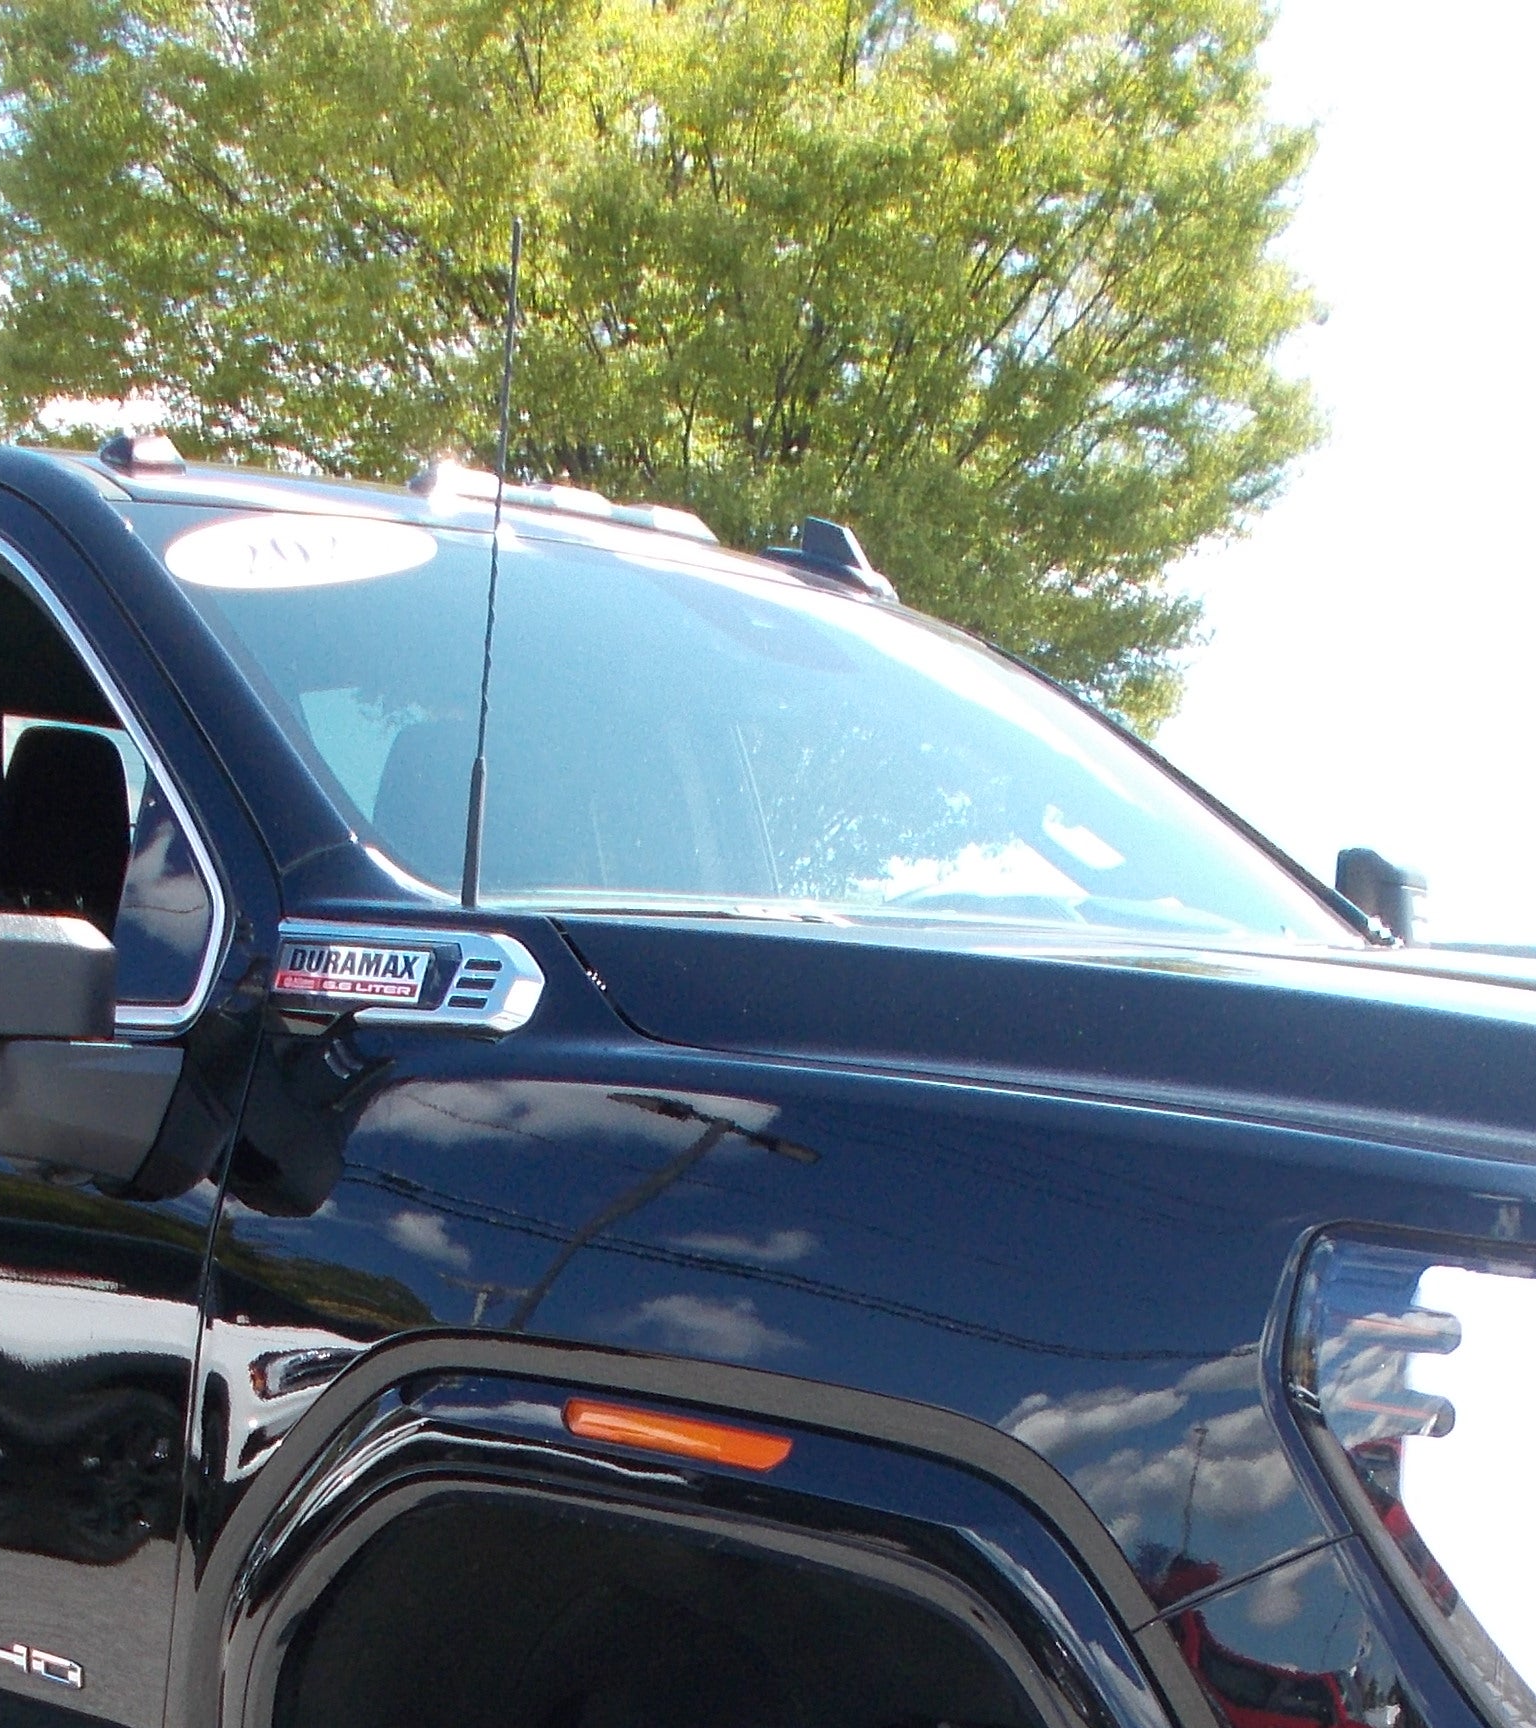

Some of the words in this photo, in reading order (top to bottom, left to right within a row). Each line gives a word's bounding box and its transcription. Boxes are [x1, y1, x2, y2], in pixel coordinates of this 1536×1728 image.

[288, 947, 420, 980] DURAMAX
[322, 980, 353, 992] 6.6
[355, 982, 412, 996] LITER
